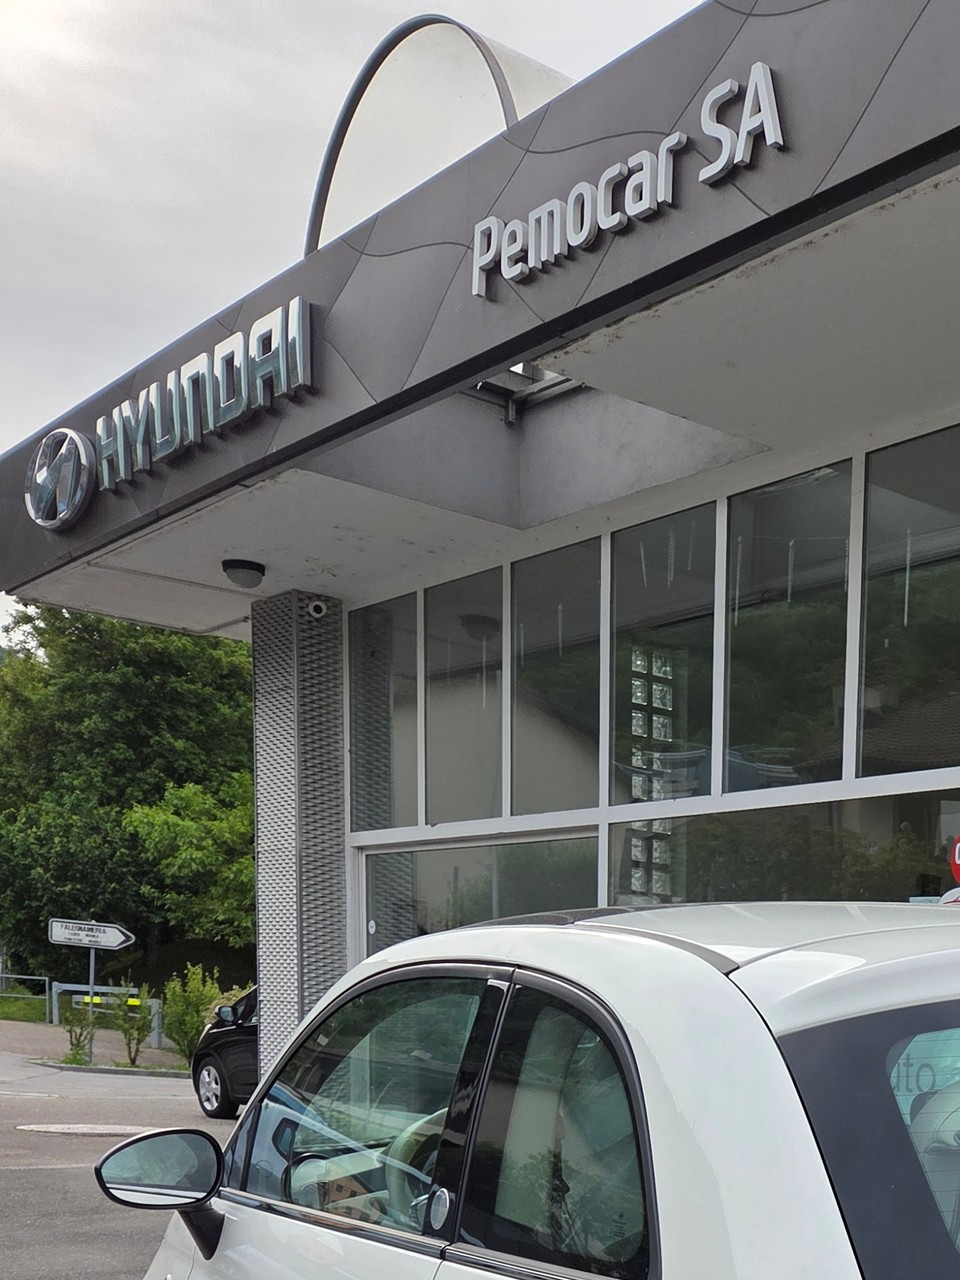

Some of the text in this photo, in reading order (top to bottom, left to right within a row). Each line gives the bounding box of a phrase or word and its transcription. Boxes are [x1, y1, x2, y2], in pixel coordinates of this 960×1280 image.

[471, 61, 784, 298] Pemocar SA
[95, 296, 313, 491] HYUNDAI
